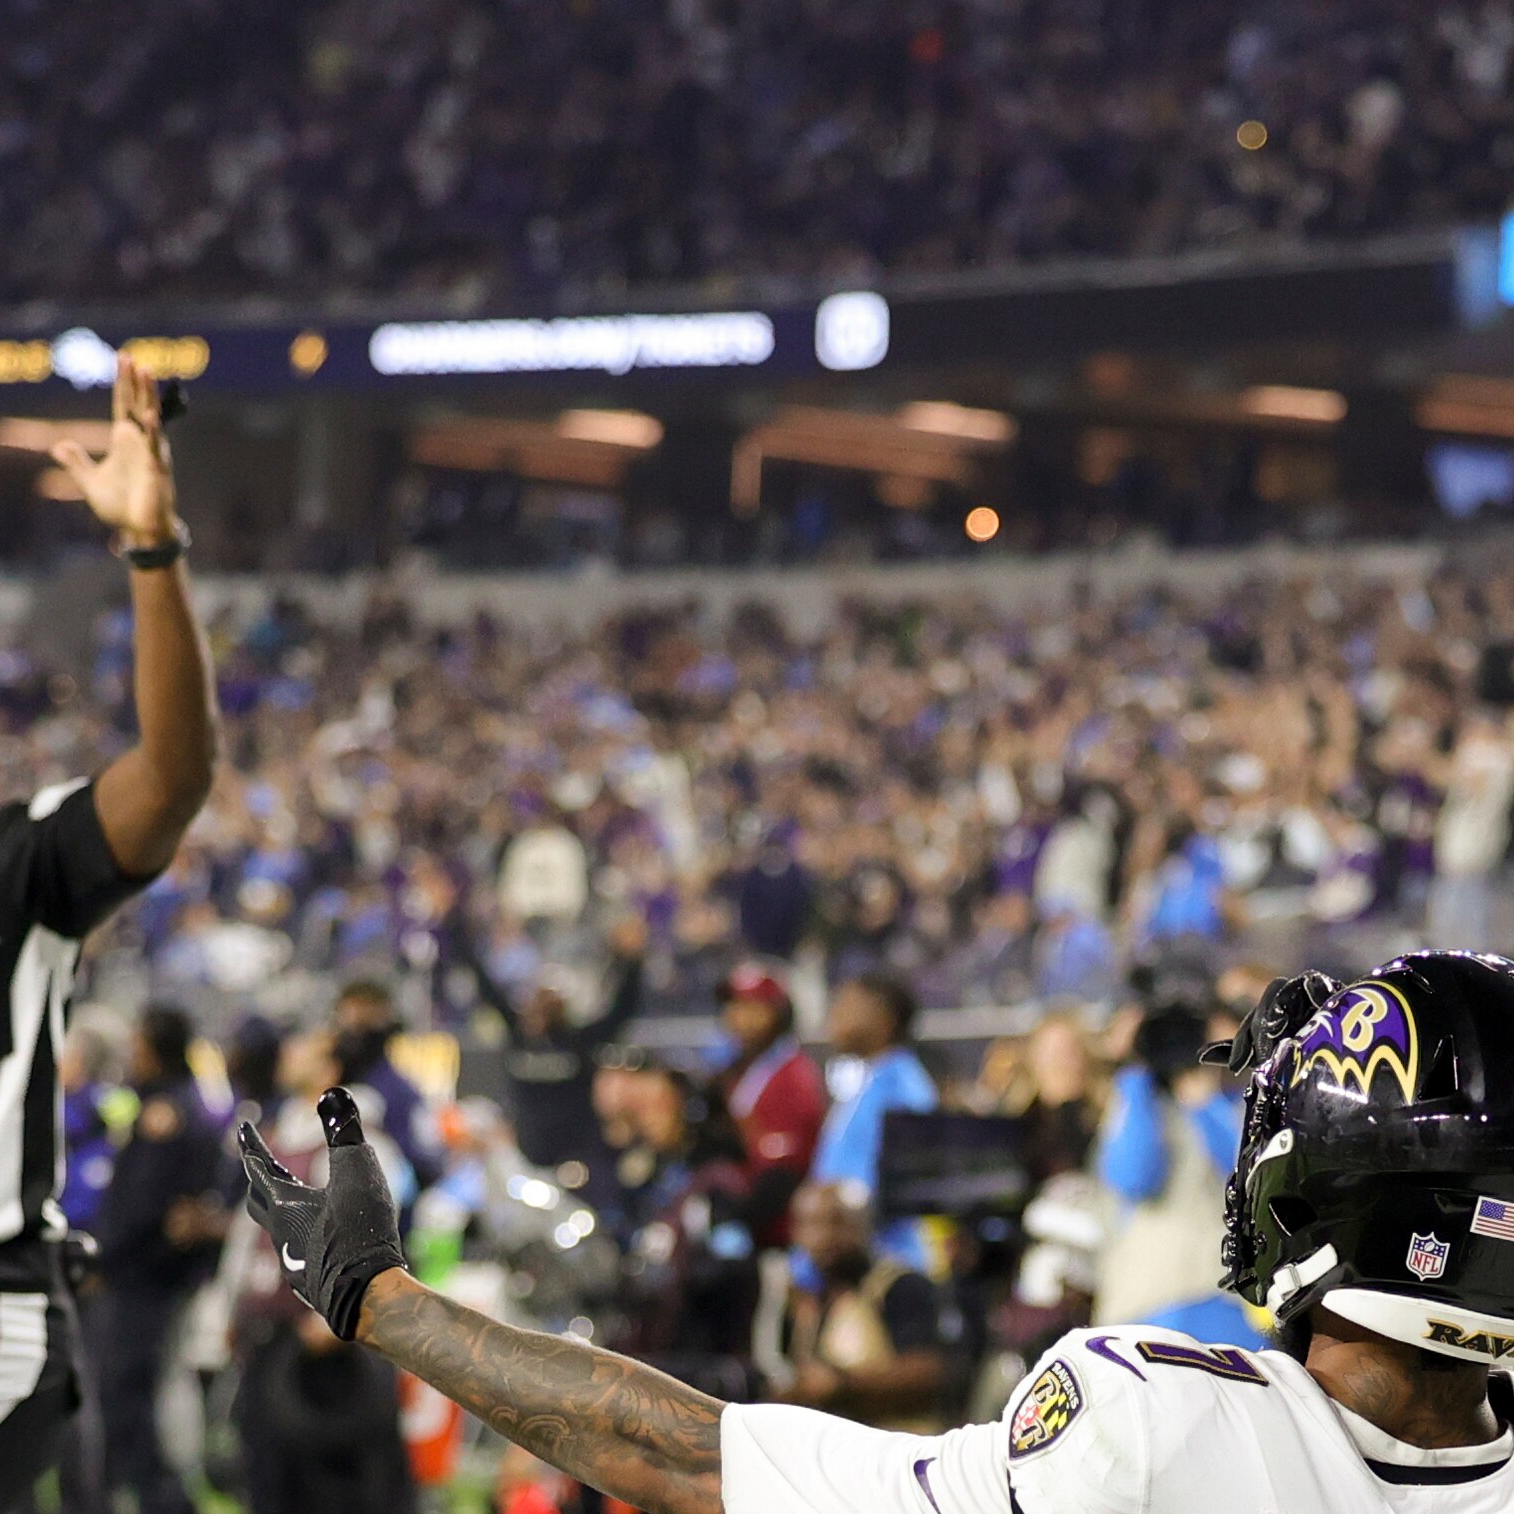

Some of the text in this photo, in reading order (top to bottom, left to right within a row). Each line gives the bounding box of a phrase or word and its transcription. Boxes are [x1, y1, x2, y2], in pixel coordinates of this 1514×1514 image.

[1341, 988, 1388, 1052] B
[1411, 1250, 1439, 1274] NFL
[1051, 1361, 1080, 1410] RAVENS
